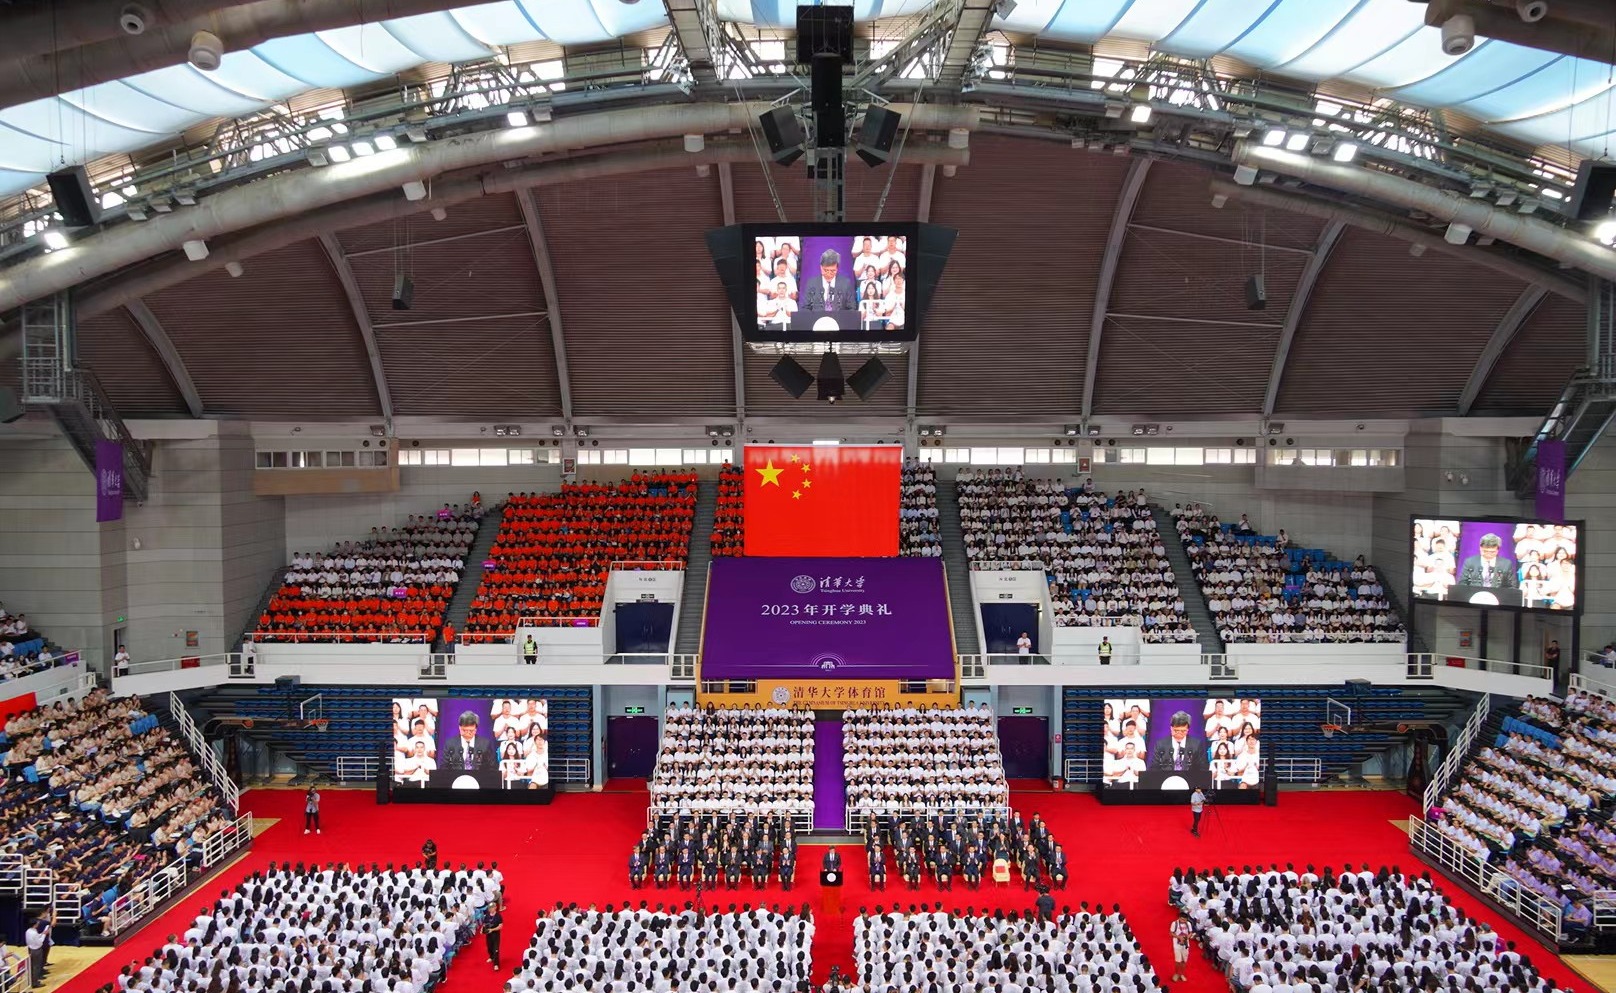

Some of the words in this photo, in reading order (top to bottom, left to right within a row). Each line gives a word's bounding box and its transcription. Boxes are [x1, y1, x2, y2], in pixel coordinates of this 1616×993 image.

[793, 686, 886, 699] 清华大学体育馆
